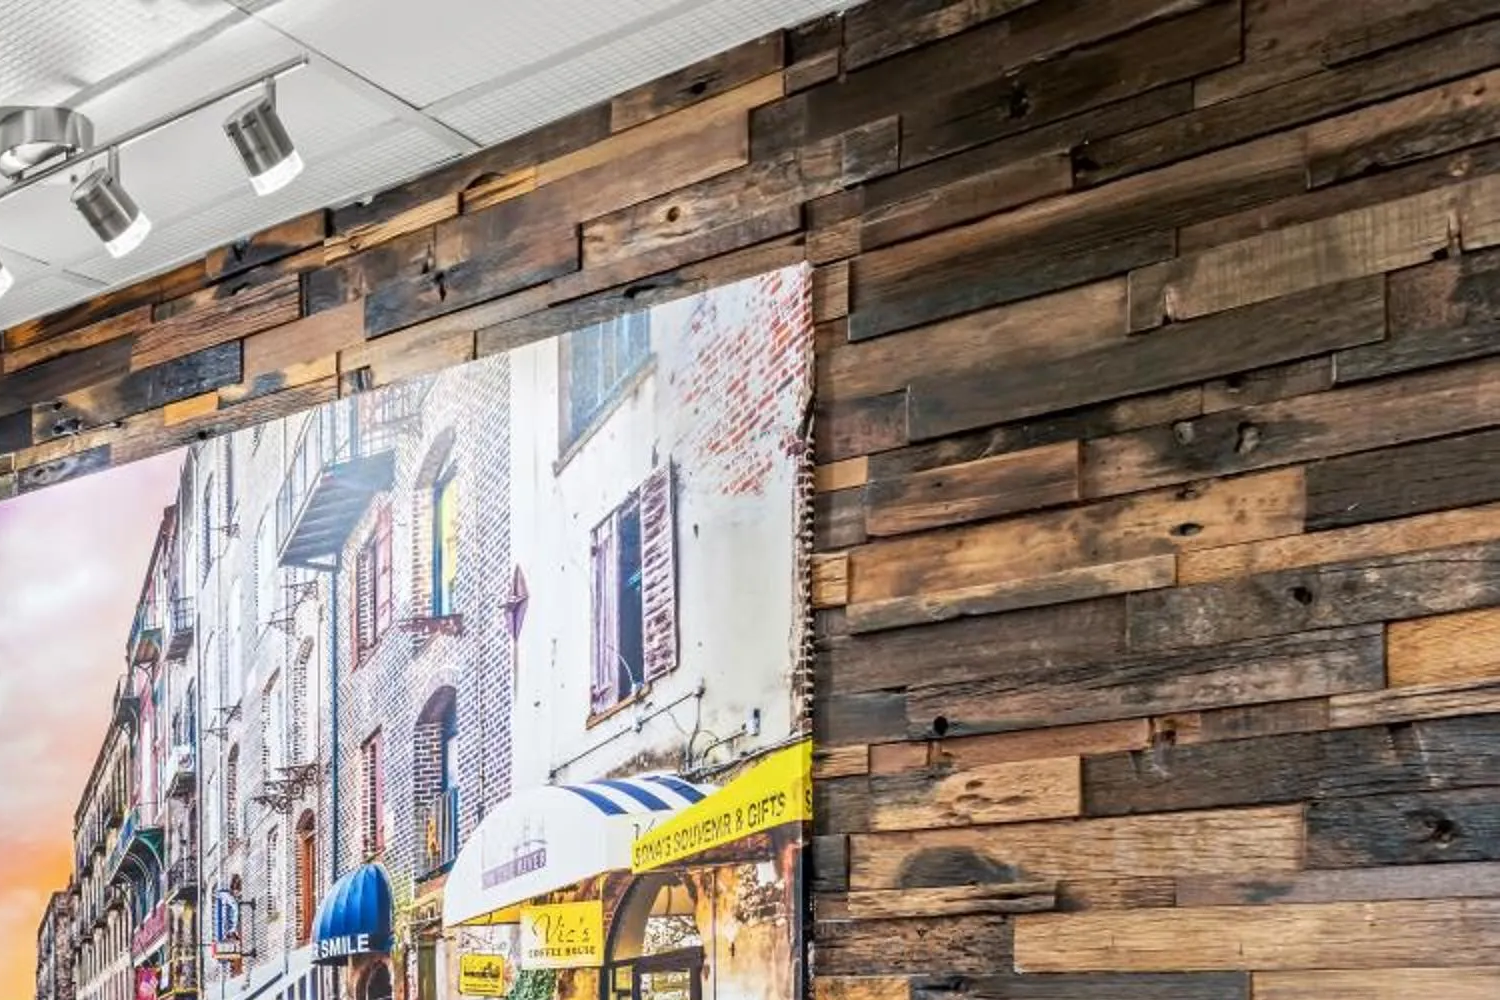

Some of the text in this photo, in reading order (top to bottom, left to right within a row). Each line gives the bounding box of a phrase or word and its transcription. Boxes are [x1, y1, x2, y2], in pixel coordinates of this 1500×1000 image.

[674, 813, 731, 851] SOUVENIR
[736, 807, 743, 832] &
[747, 792, 786, 828] GIFTS
[321, 933, 370, 958] SMILE
